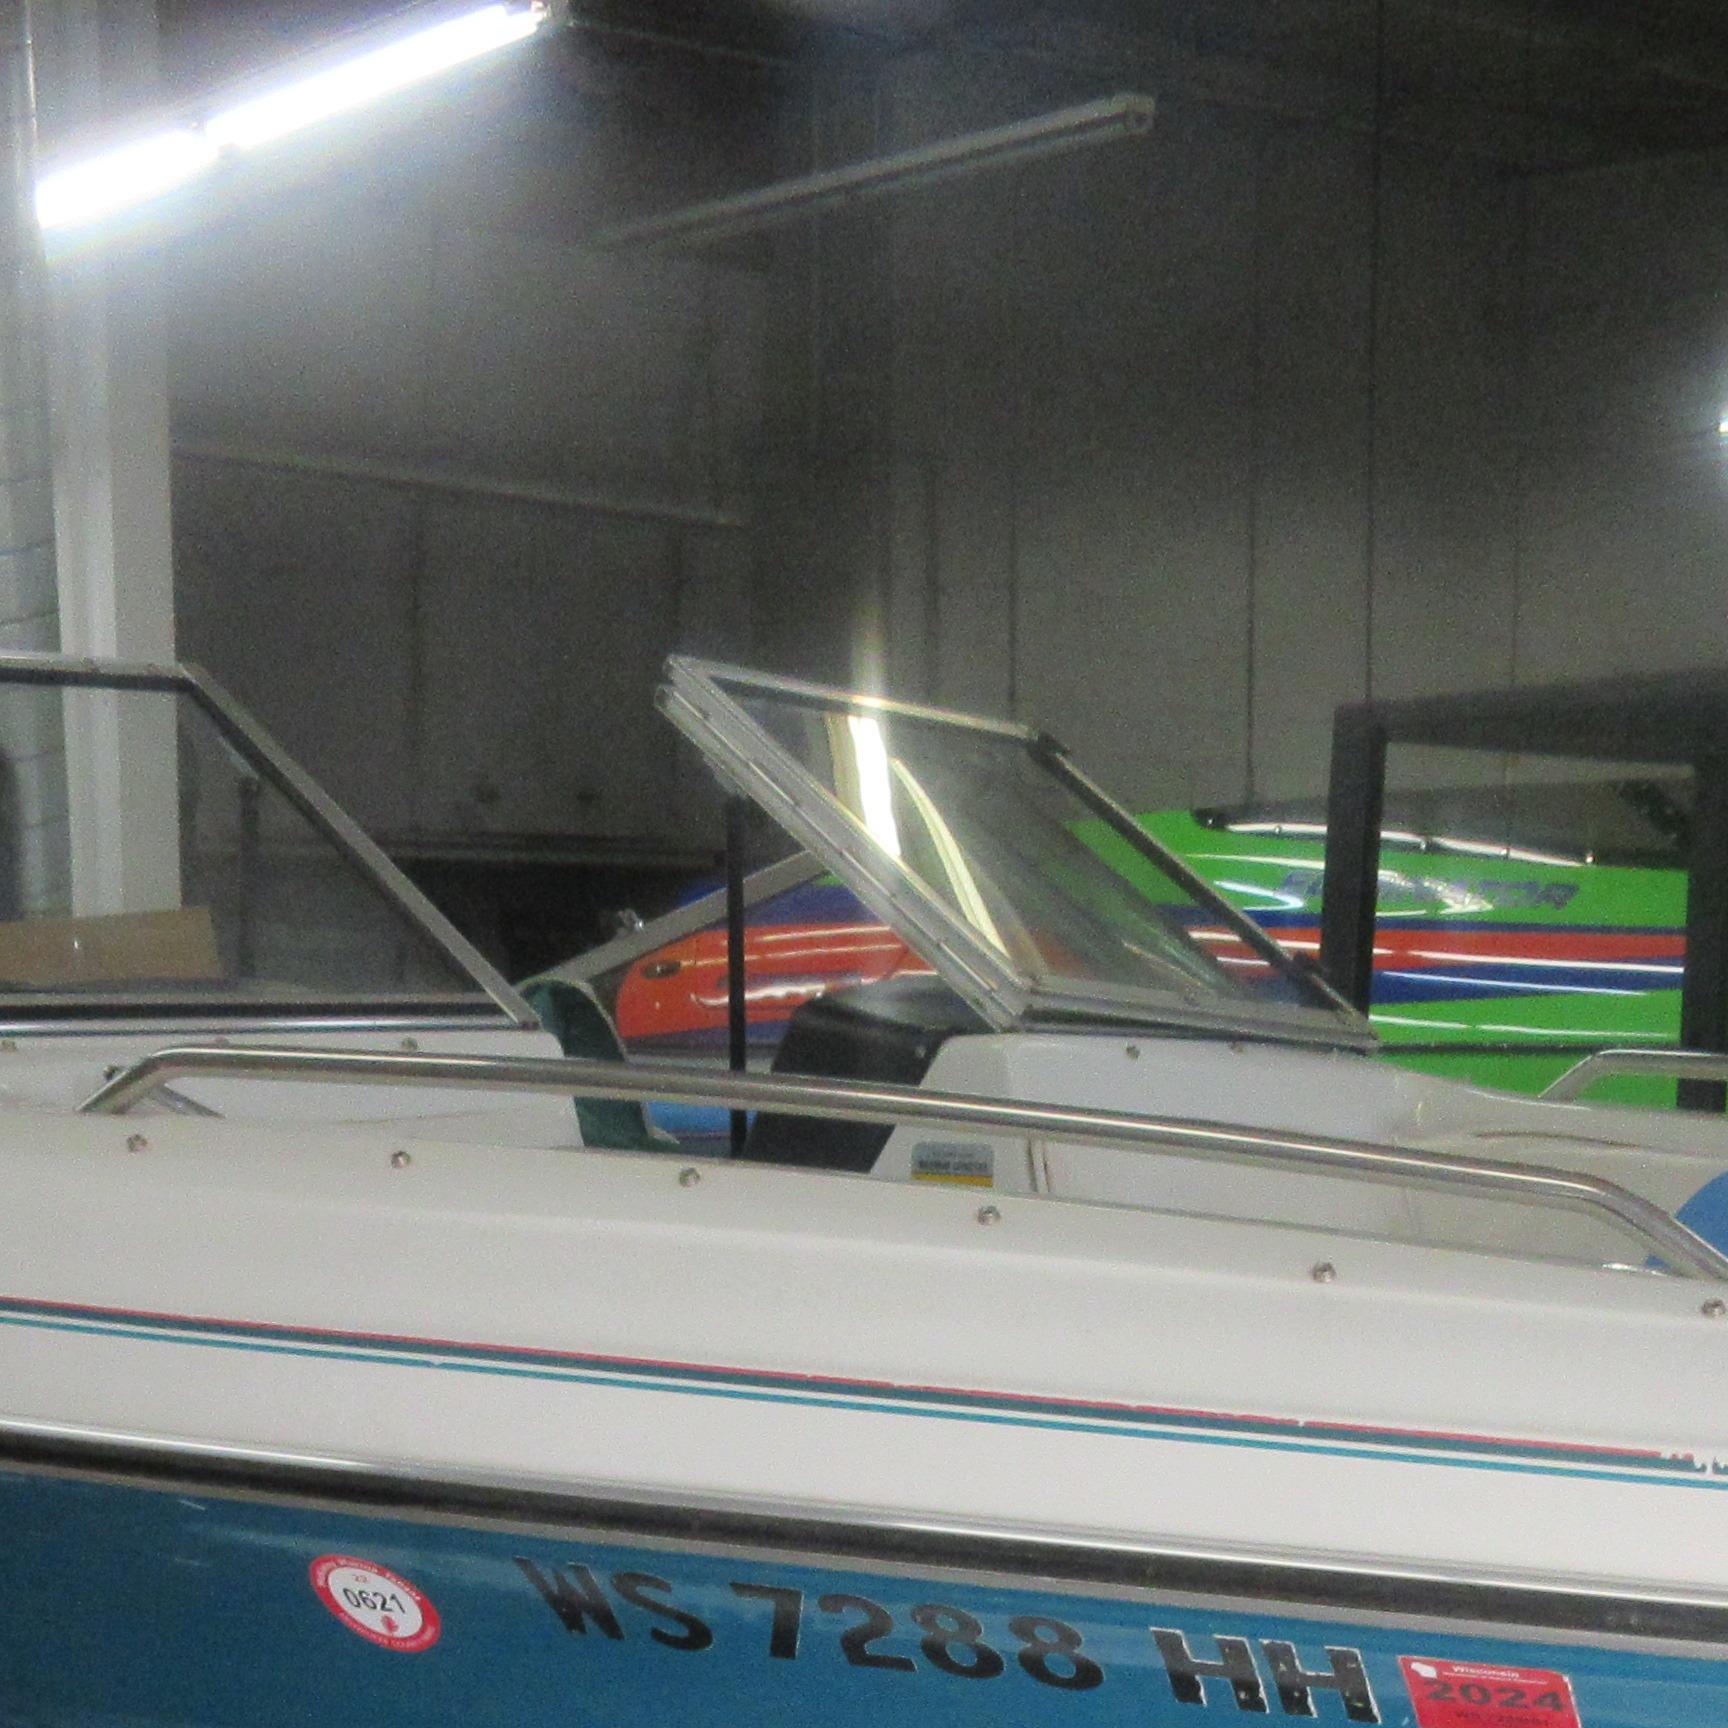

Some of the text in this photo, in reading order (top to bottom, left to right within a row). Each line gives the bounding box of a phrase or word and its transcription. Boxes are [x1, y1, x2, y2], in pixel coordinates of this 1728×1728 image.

[343, 1587, 406, 1615] 0621
[511, 1555, 1382, 1724] WS 7288 HH
[1452, 1664, 1520, 1679] Wisconsin
[1424, 1679, 1564, 1712] 2024
